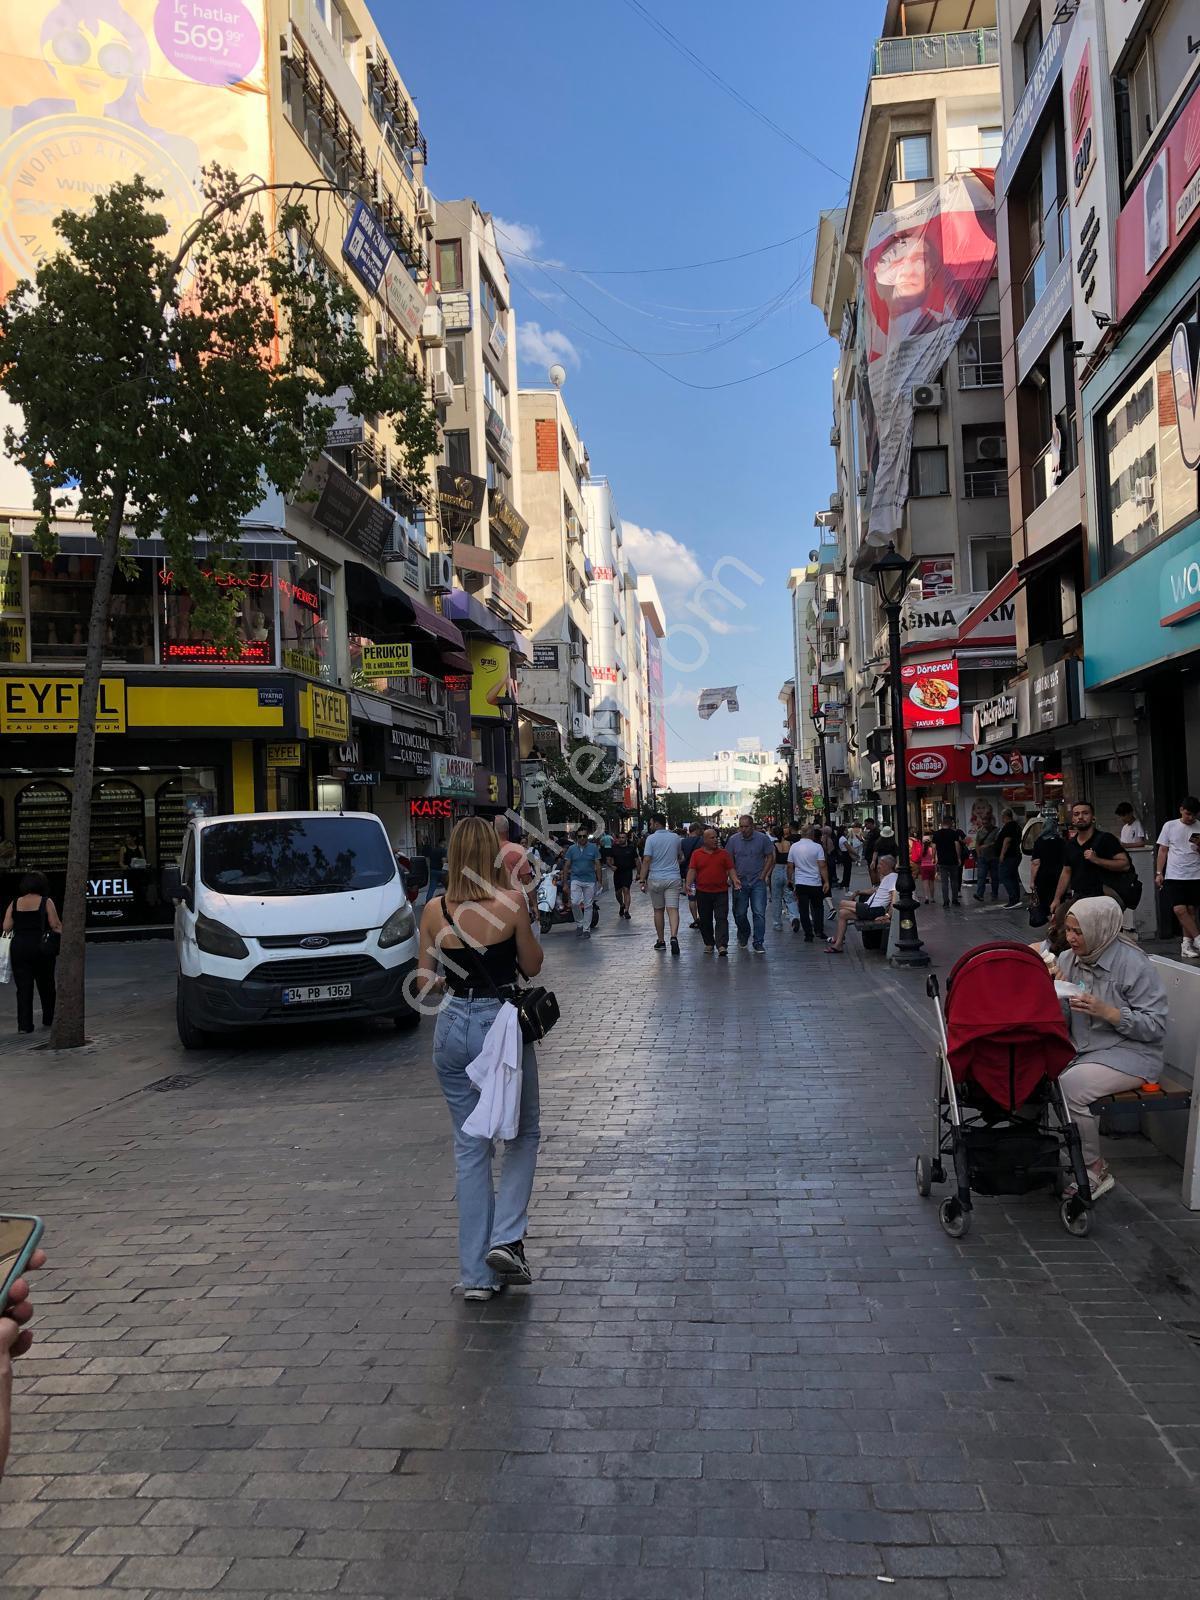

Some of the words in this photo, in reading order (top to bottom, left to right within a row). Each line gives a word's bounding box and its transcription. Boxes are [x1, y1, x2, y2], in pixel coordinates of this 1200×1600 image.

[193, 3, 240, 25] hatlar
[56, 177, 109, 194] WINN
[363, 645, 409, 660] PERUKÇU
[917, 661, 953, 675] Dönerevi
[6, 683, 119, 713] EYFL
[314, 691, 346, 724] EYFEL
[391, 730, 430, 750] KUYUMCULAR
[268, 746, 299, 757] EYFEL
[340, 743, 359, 763] CAN
[353, 773, 373, 782] CAN
[411, 799, 453, 818] KARS
[86, 878, 134, 895] YFEL
[289, 988, 301, 1000] 34
[308, 987, 320, 998] PB
[328, 985, 350, 996] 1362
